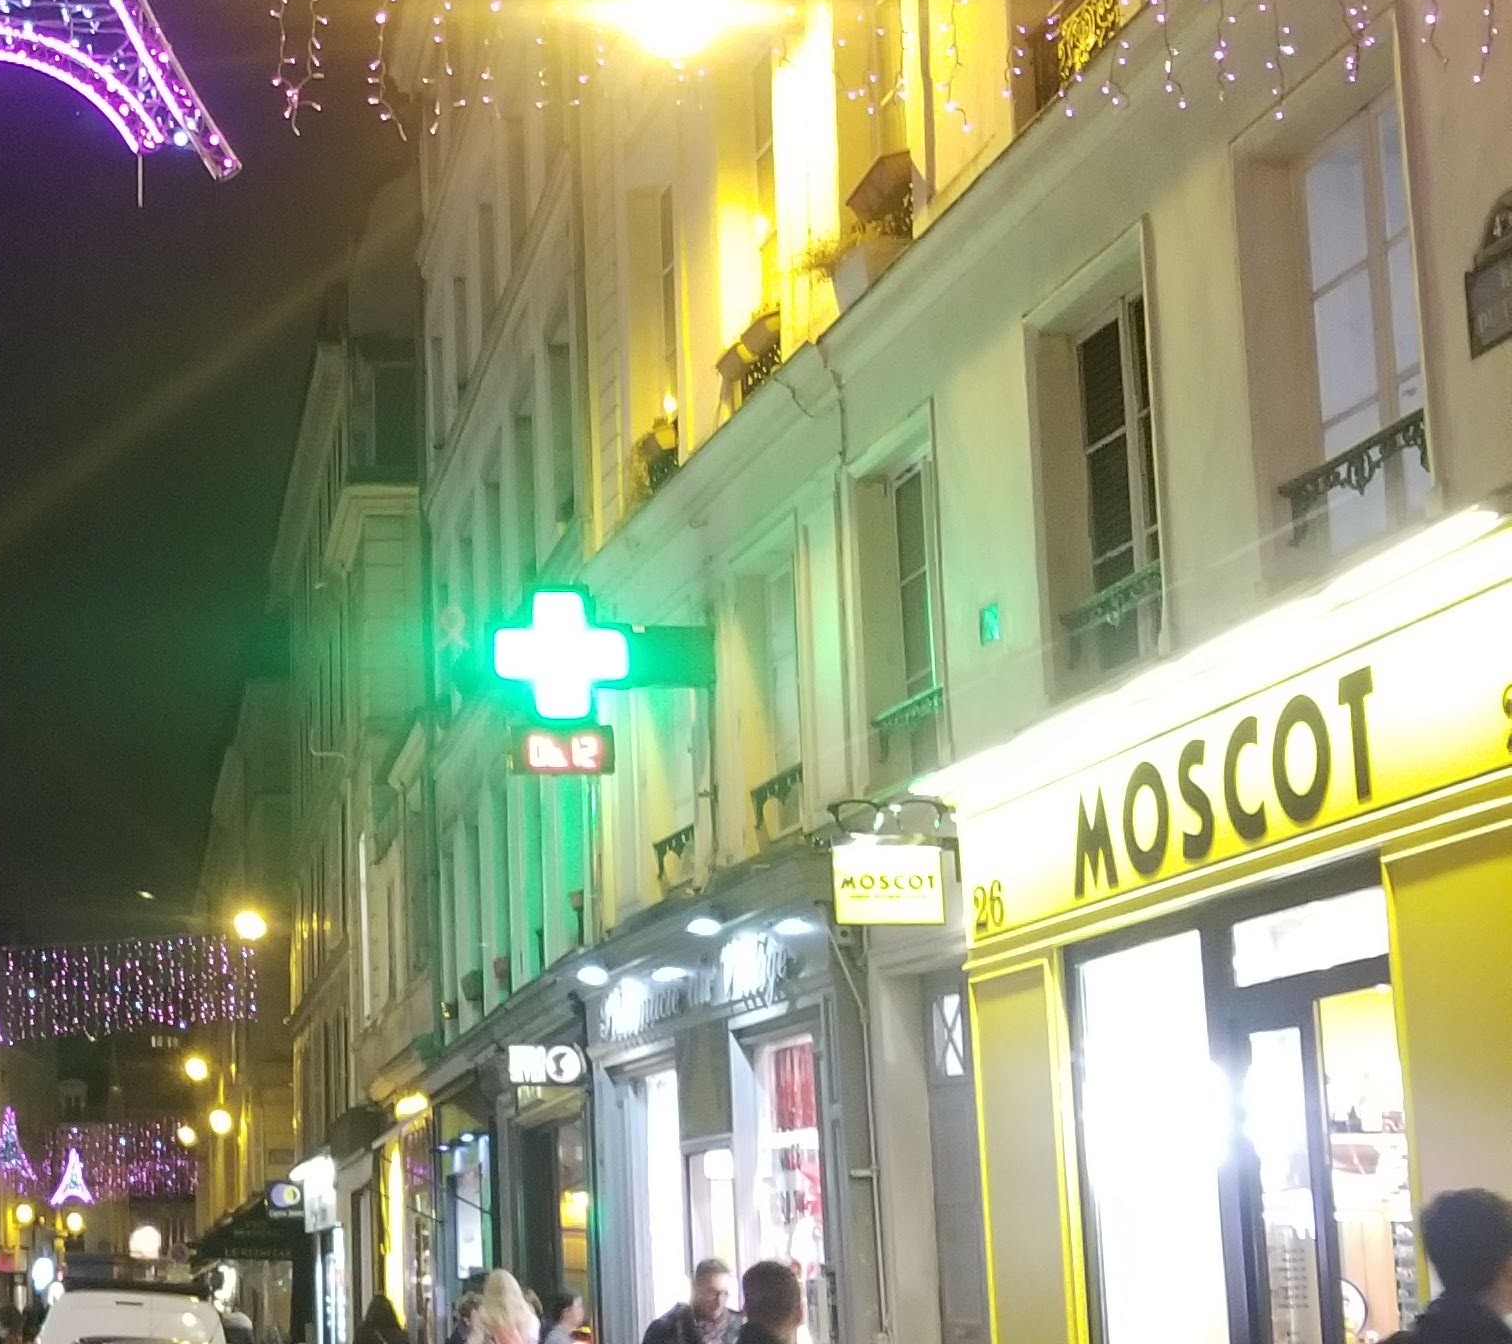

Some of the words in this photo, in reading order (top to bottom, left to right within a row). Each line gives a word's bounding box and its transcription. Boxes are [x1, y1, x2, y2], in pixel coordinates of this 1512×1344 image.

[1074, 665, 1374, 900] MOSCOT
[840, 875, 935, 890] MOSCOT
[973, 879, 1005, 929] 26
